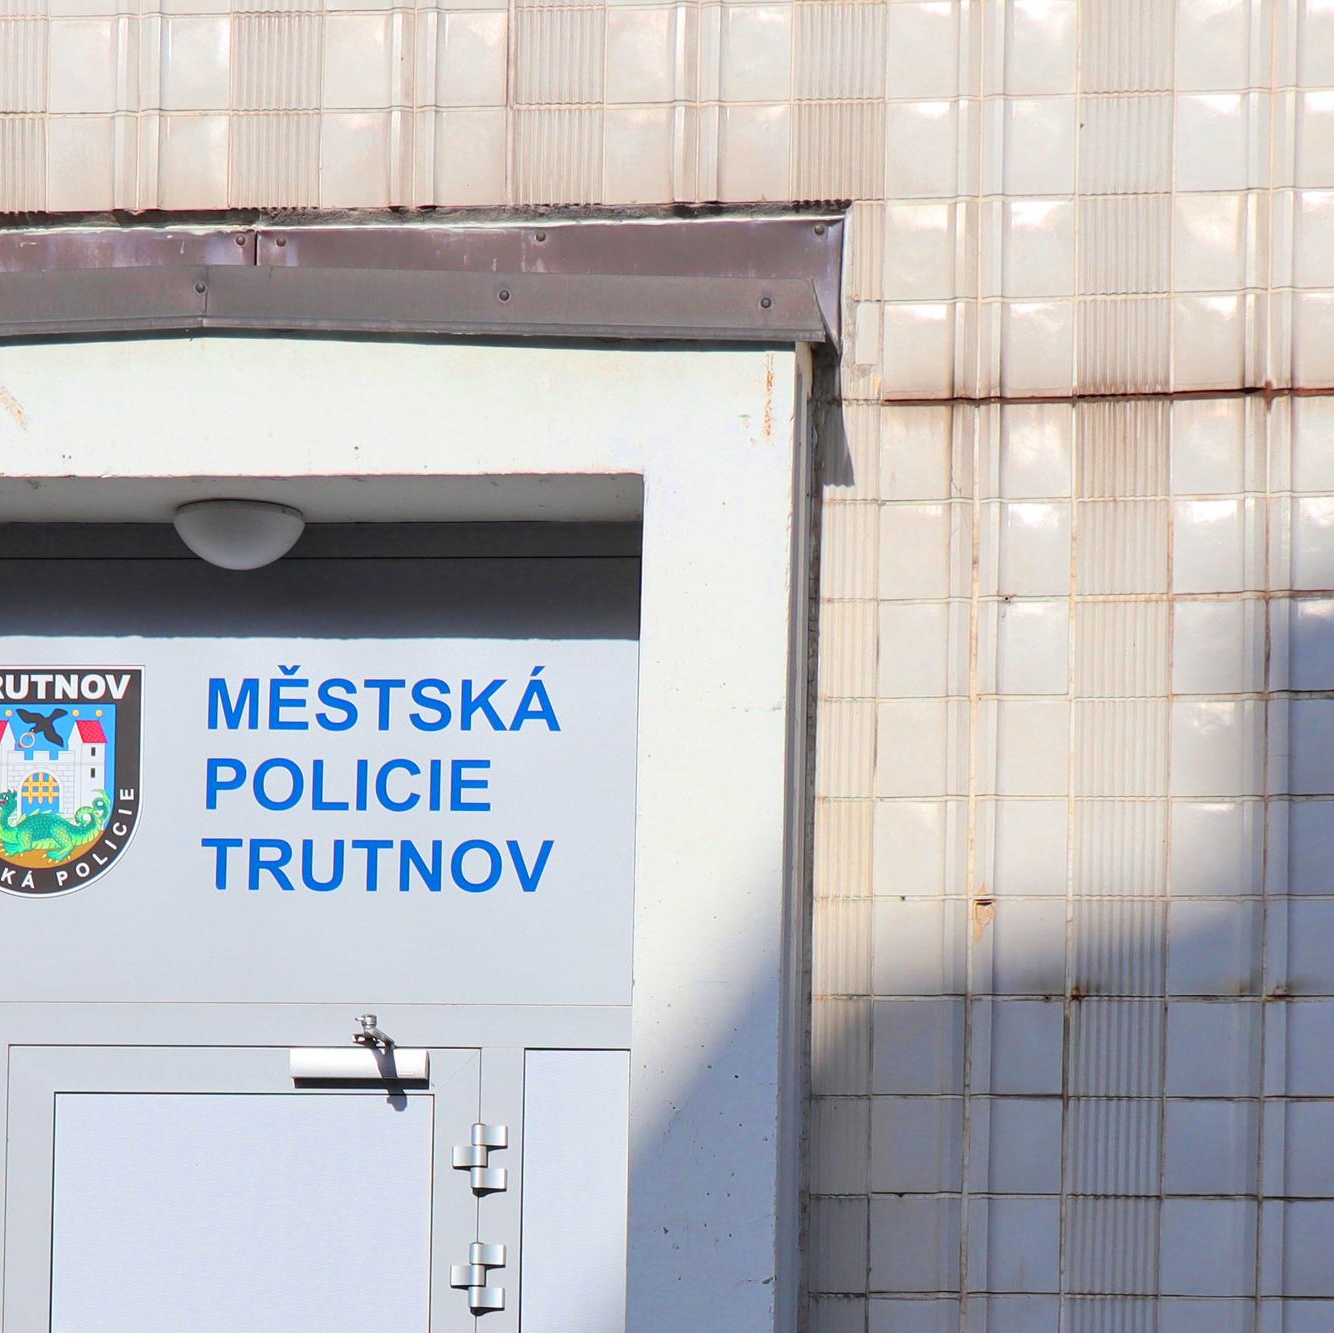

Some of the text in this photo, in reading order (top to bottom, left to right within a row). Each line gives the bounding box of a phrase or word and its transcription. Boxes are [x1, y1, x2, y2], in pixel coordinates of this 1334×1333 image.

[208, 664, 561, 732] MĚSTSKÁ
[206, 758, 492, 812] POLICIE
[56, 788, 134, 887] POLICIE
[202, 838, 555, 893] TRUTNOV
